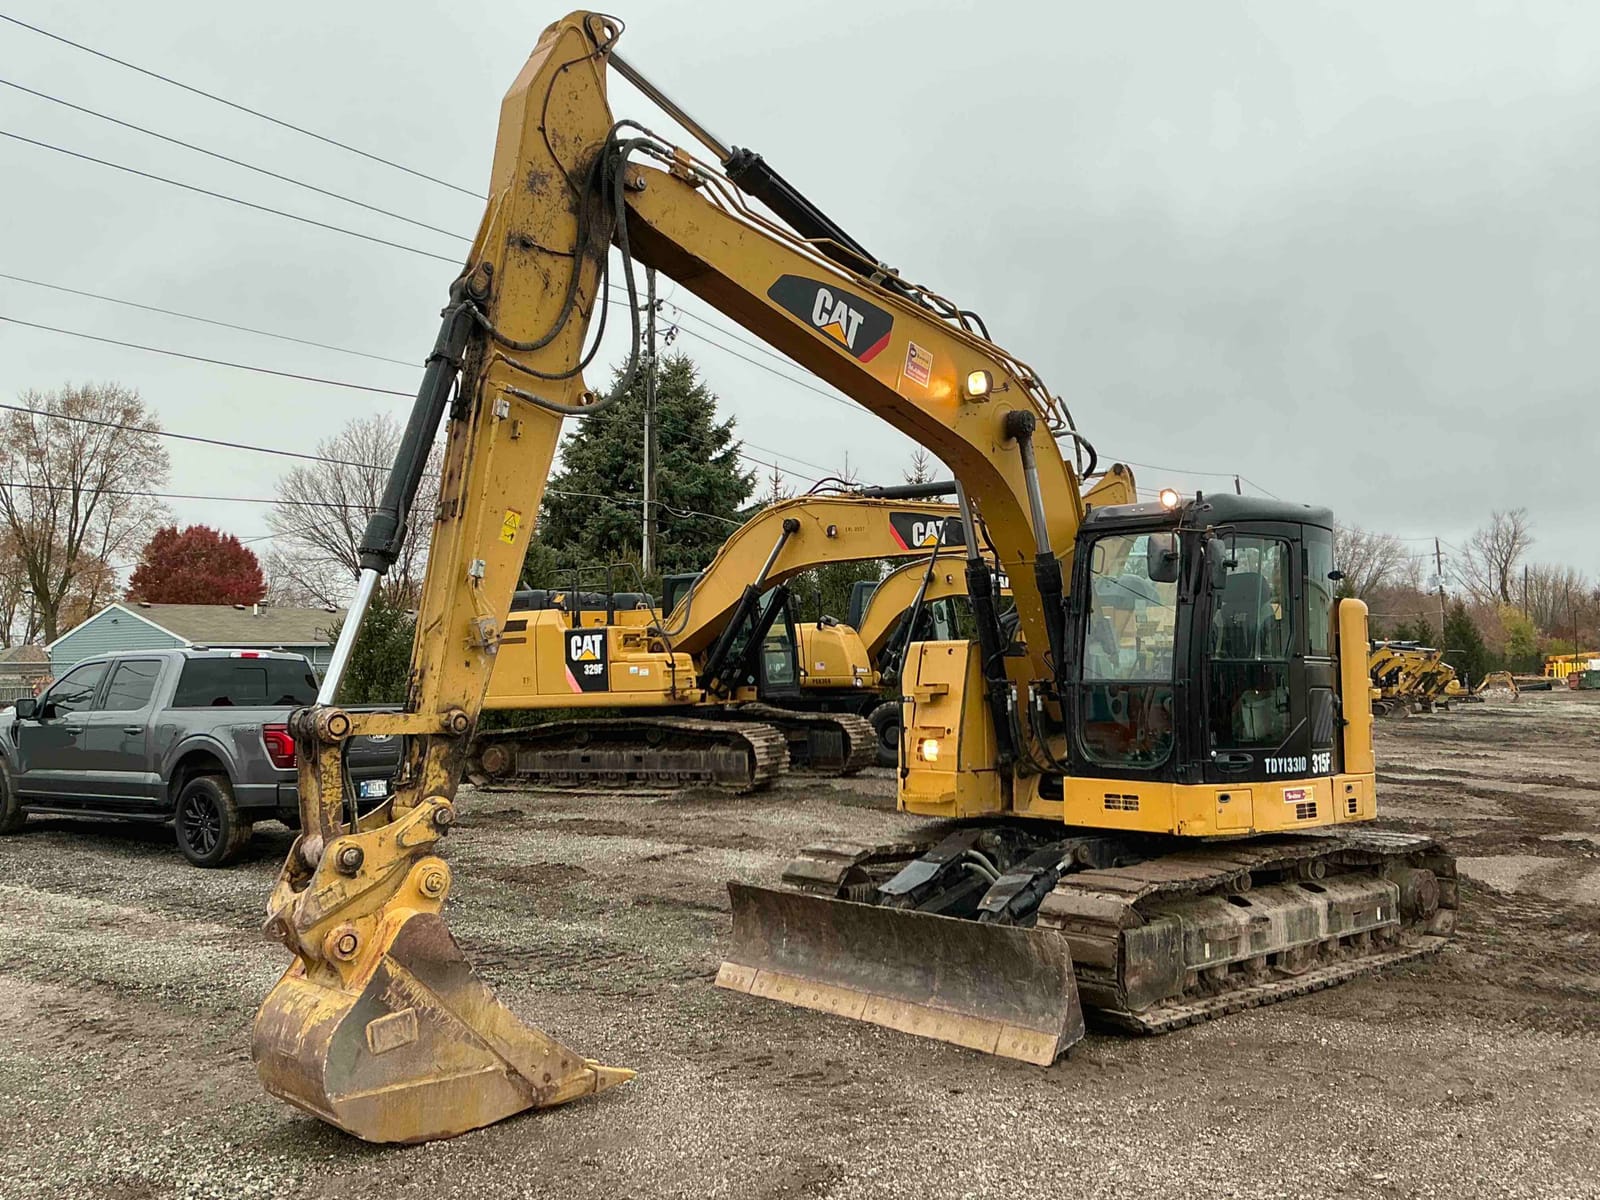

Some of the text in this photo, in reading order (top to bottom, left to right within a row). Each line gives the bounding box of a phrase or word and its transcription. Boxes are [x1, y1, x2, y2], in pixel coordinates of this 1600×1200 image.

[812, 287, 864, 349] CAT
[570, 634, 603, 661] CAT
[583, 664, 604, 675] 329F
[1312, 752, 1331, 774] 315F
